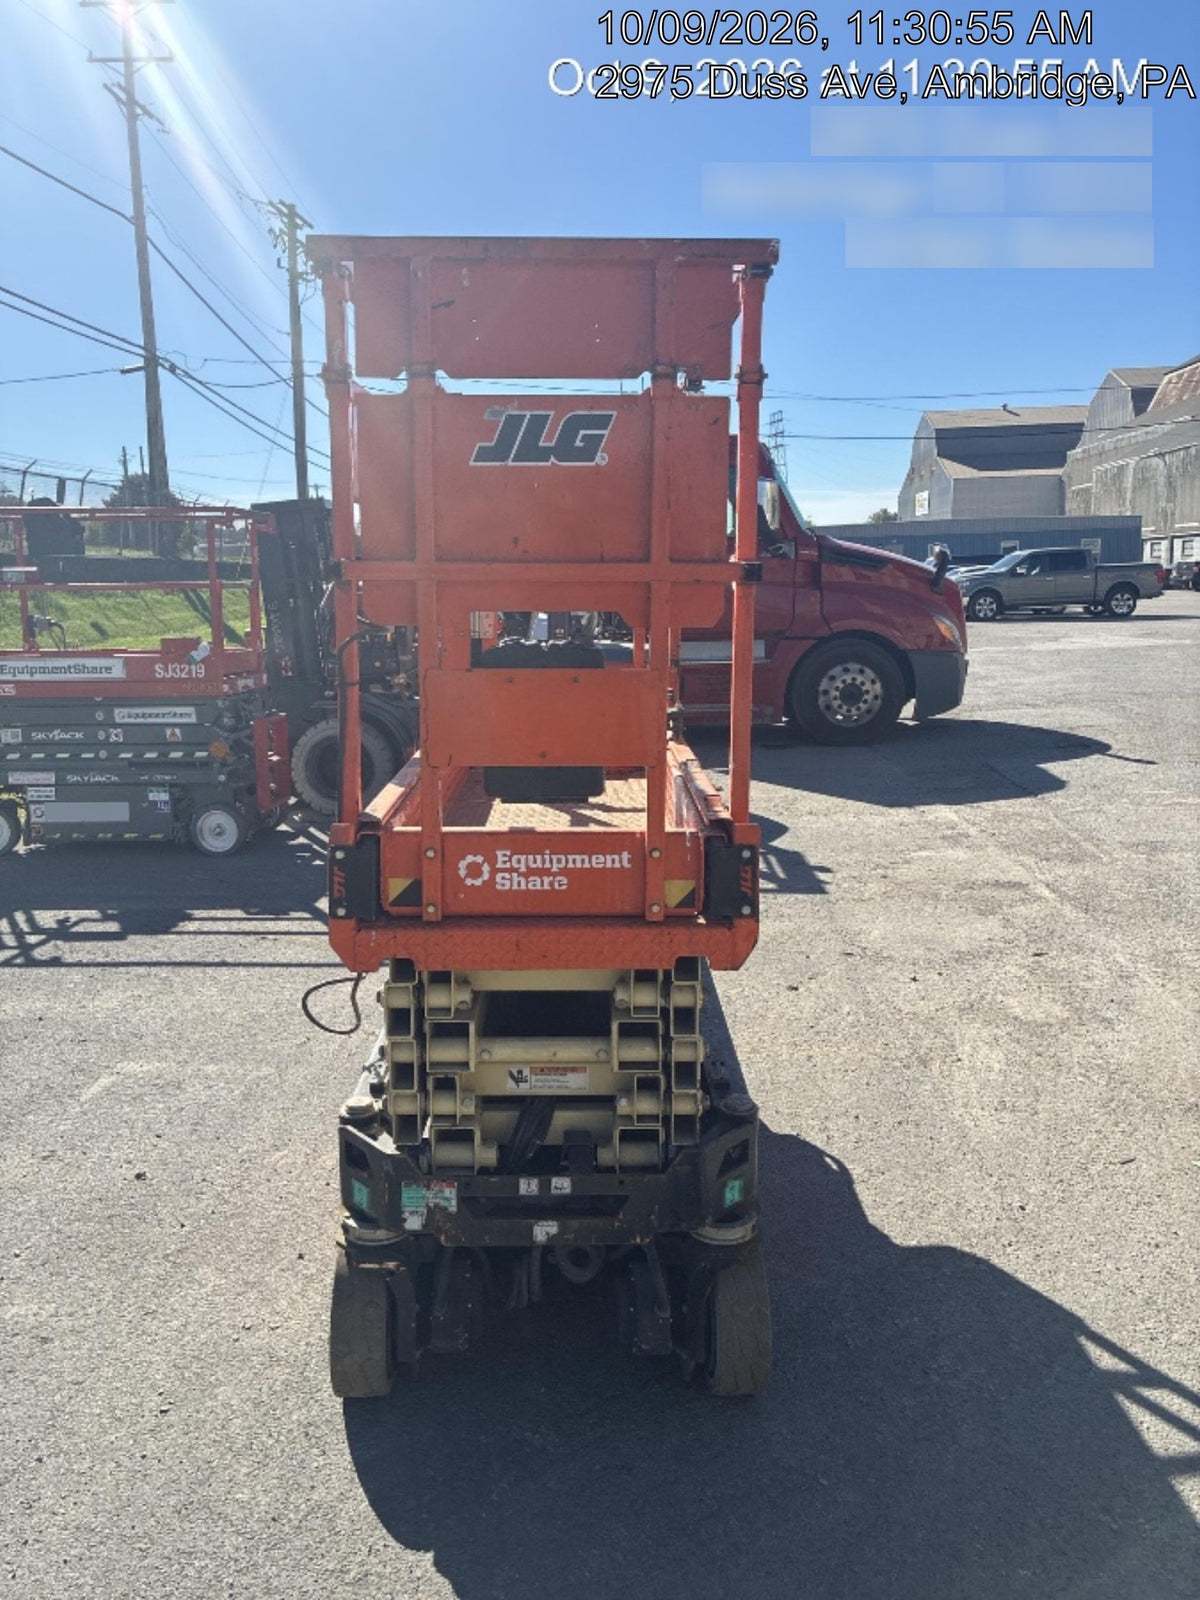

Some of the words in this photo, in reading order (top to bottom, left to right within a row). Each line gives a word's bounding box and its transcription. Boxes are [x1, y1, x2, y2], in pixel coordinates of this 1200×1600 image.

[469, 410, 617, 466] JLG
[0, 663, 114, 678] EquipmentShare
[154, 662, 206, 679] SJ3219
[496, 851, 632, 872] Equipment
[496, 873, 568, 890] Share
